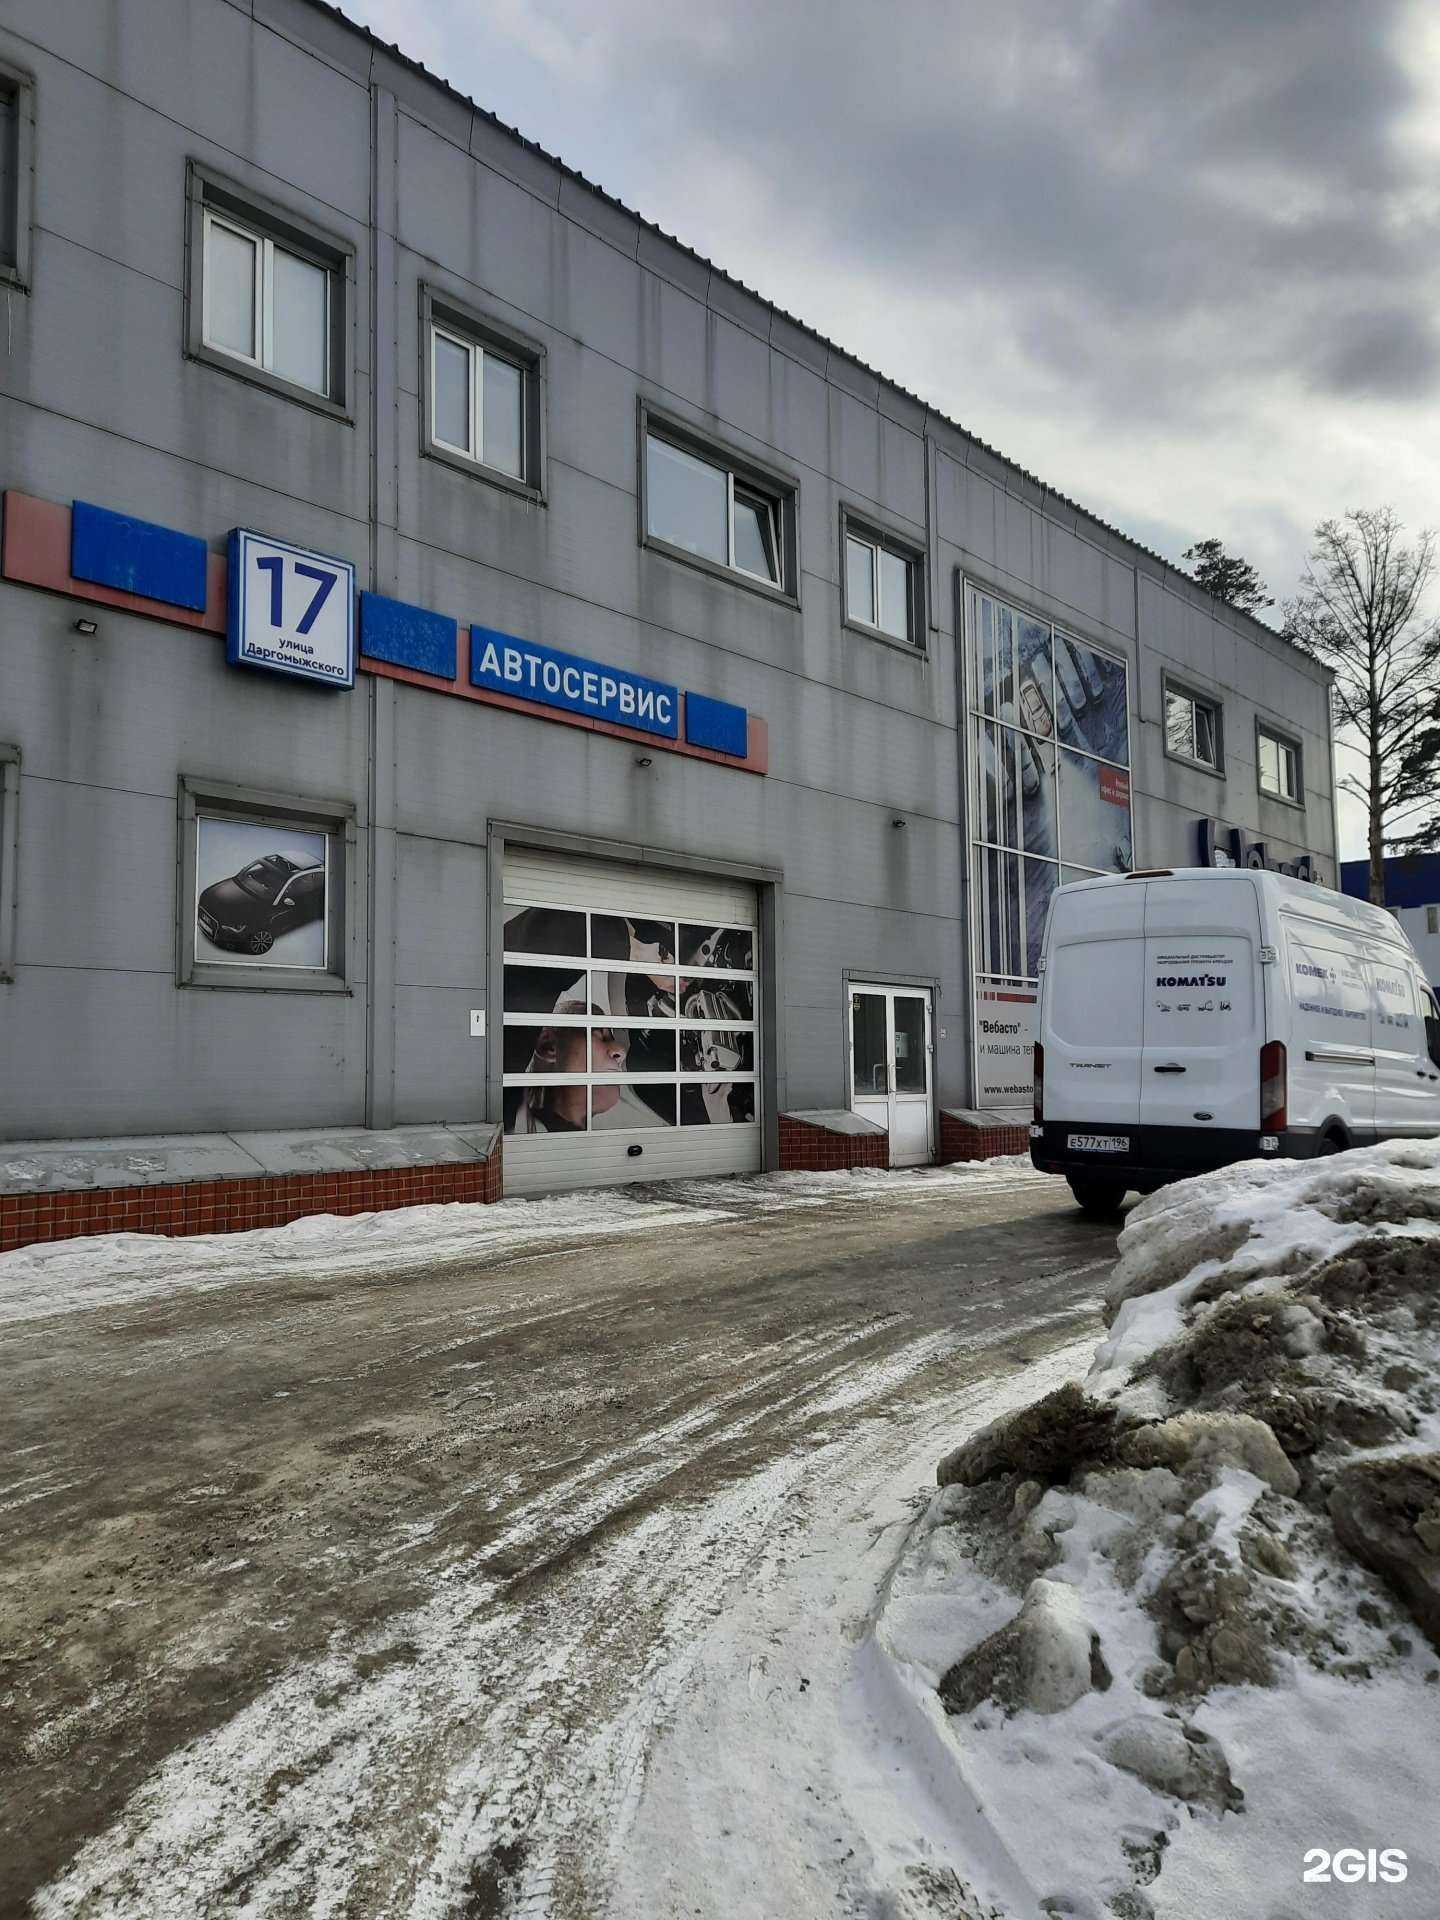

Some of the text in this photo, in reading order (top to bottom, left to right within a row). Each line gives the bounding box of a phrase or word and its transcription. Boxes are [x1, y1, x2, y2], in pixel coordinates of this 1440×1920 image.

[256, 556, 338, 635] 17
[279, 638, 314, 655] улица
[246, 642, 345, 676] Даргомыжского
[479, 642, 671, 724] АВТОСЕРВИС
[1156, 974, 1227, 987] KOMATSU
[979, 1020, 1021, 1034] "Вебасто"
[987, 1043, 1021, 1056] машина
